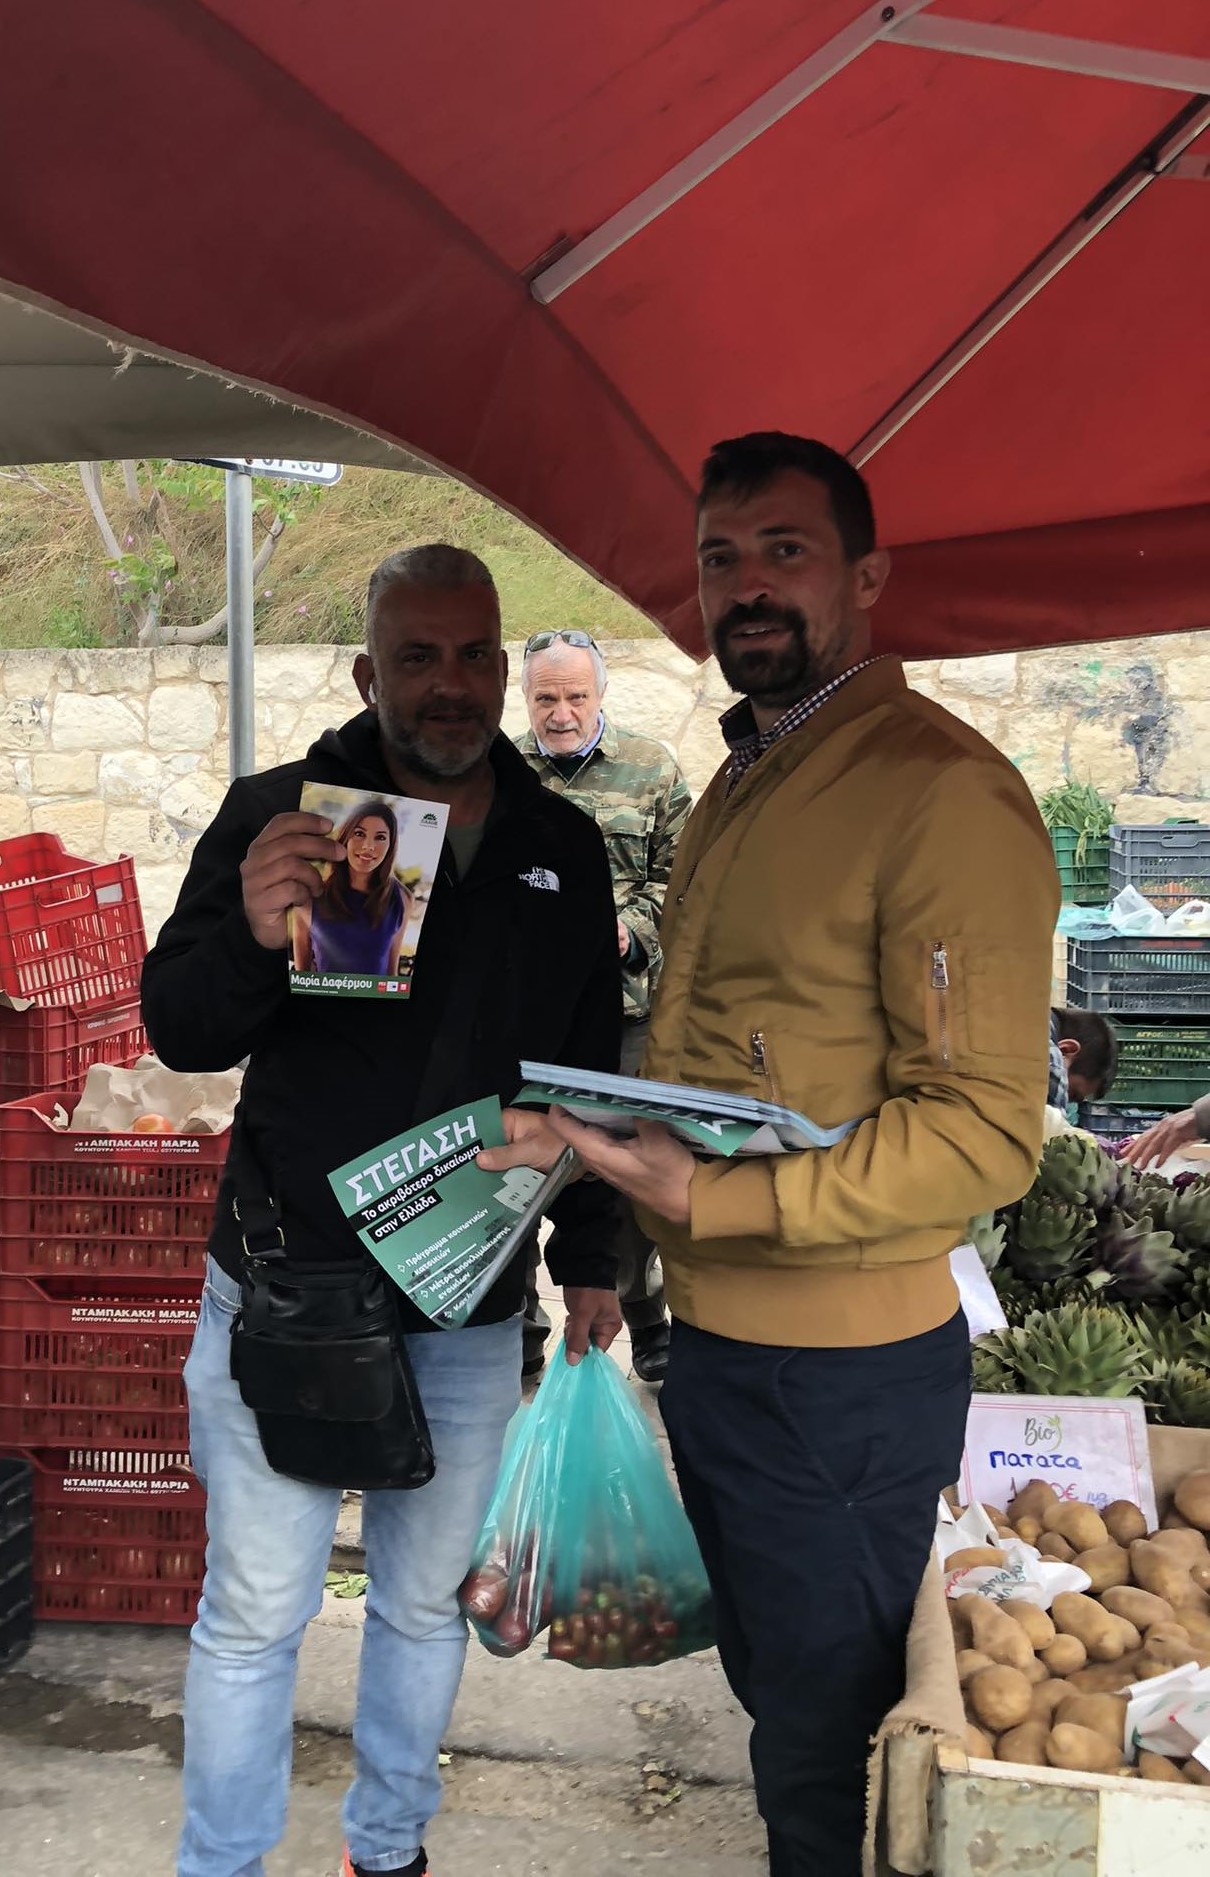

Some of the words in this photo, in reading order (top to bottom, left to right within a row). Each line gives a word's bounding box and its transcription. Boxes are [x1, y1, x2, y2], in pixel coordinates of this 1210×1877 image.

[291, 974, 320, 988] Μαρία
[322, 976, 373, 990] Δαφέρμου
[161, 1140, 200, 1148] ΜΑΡΙΑ
[346, 1115, 477, 1206] ΣΤΕΓΑΣΗ
[361, 1208, 377, 1221] Το
[377, 1173, 434, 1213] ακριβότερο
[434, 1144, 481, 1177] δικαίωμα
[374, 1216, 400, 1238] στην
[399, 1194, 437, 1222] Ελλάδα
[405, 1237, 449, 1267] Πρόγραμμα
[447, 1208, 489, 1239] κοινωνικών
[414, 1247, 451, 1276] κατοικιών
[428, 1271, 455, 1293] Μέτρα
[71, 1308, 156, 1317] ΝΤΑΜΠΑΚΑΚΗ
[159, 1310, 198, 1318] ΜΑΡΙΑ
[1024, 1417, 1056, 1446] Bio
[63, 1478, 147, 1488] ΝΤΑΜΠΑΚΑΚΗ
[150, 1481, 190, 1490] ΜΑΡΙΑ
